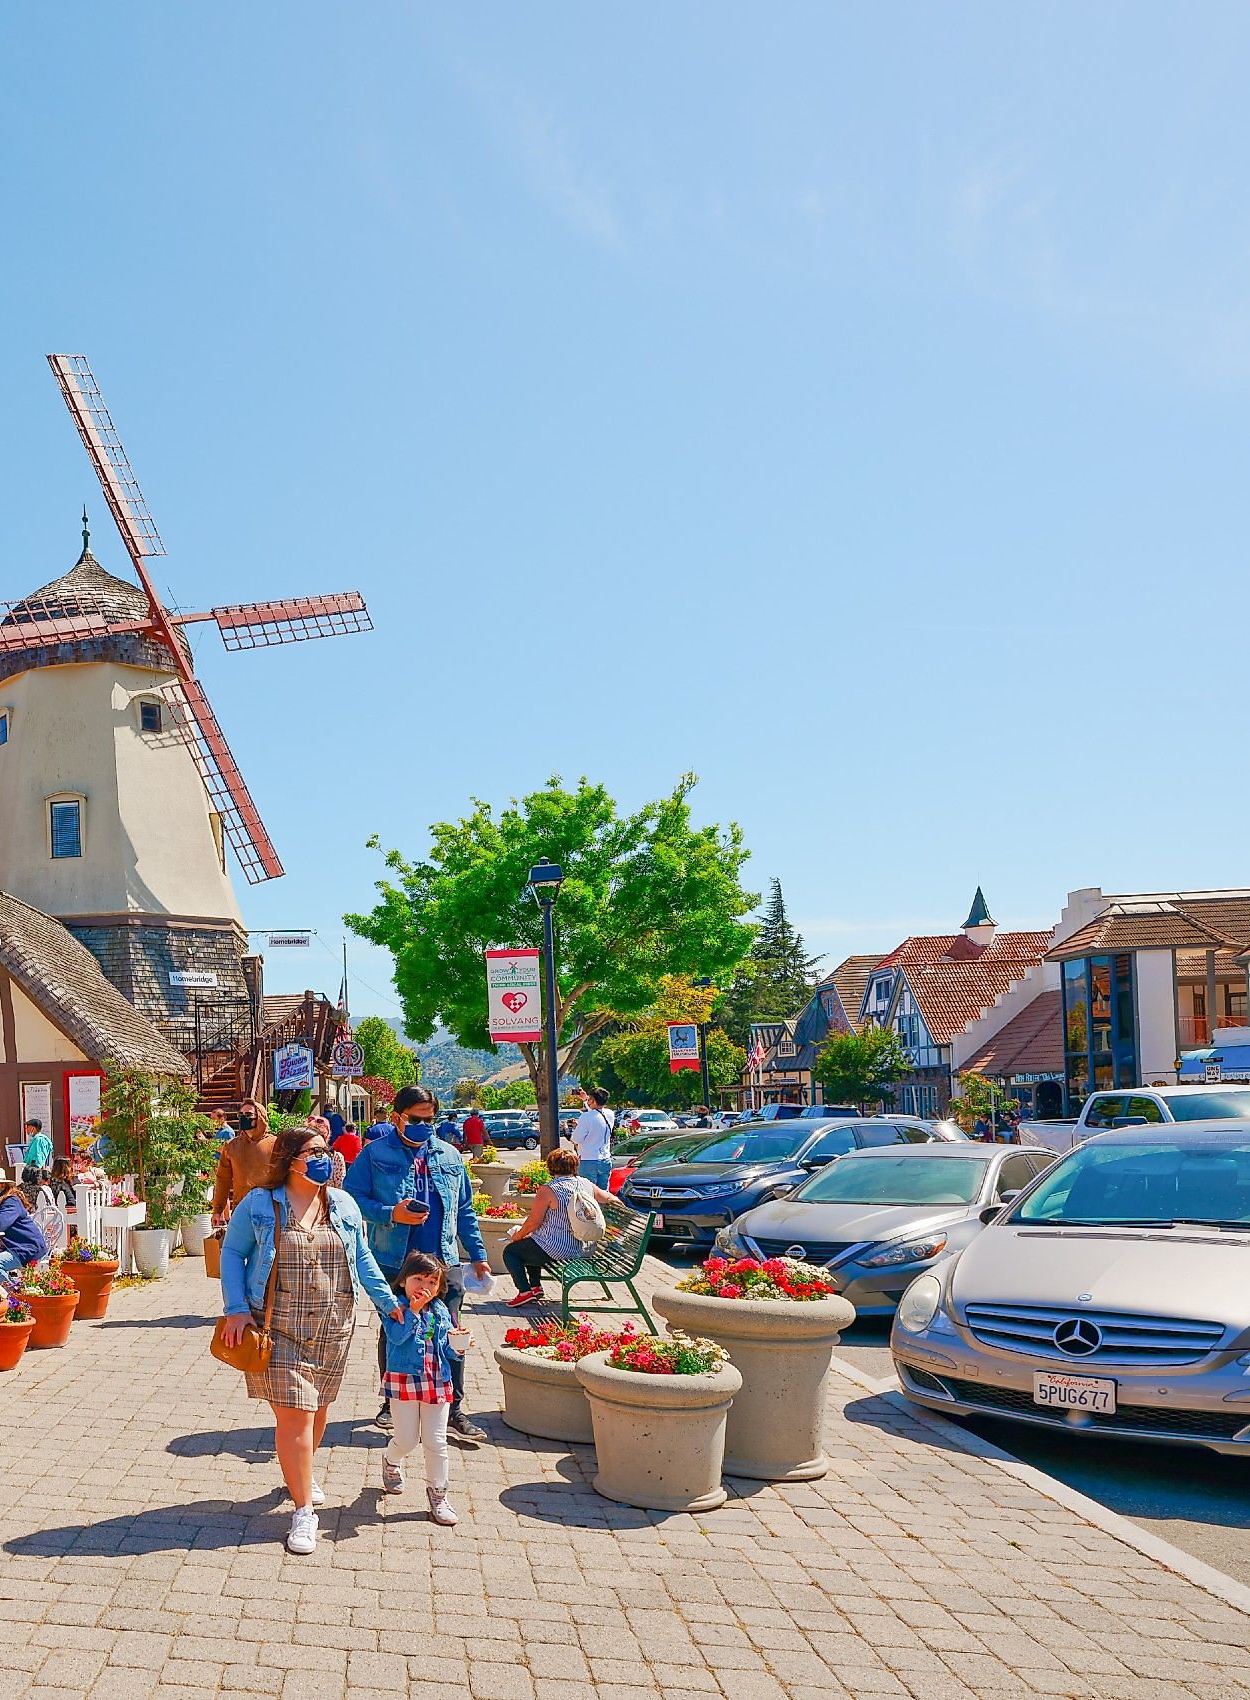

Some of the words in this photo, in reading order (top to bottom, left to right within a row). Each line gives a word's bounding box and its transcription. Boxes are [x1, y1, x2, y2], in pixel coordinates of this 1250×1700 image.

[172, 973, 213, 984] Homebridge
[490, 974, 536, 982] COMMUNITY
[492, 1017, 539, 1026] SOLVANG
[279, 1065, 309, 1080] Pizza
[1050, 1375, 1095, 1388] California
[1038, 1384, 1109, 1408] 5PUG677
